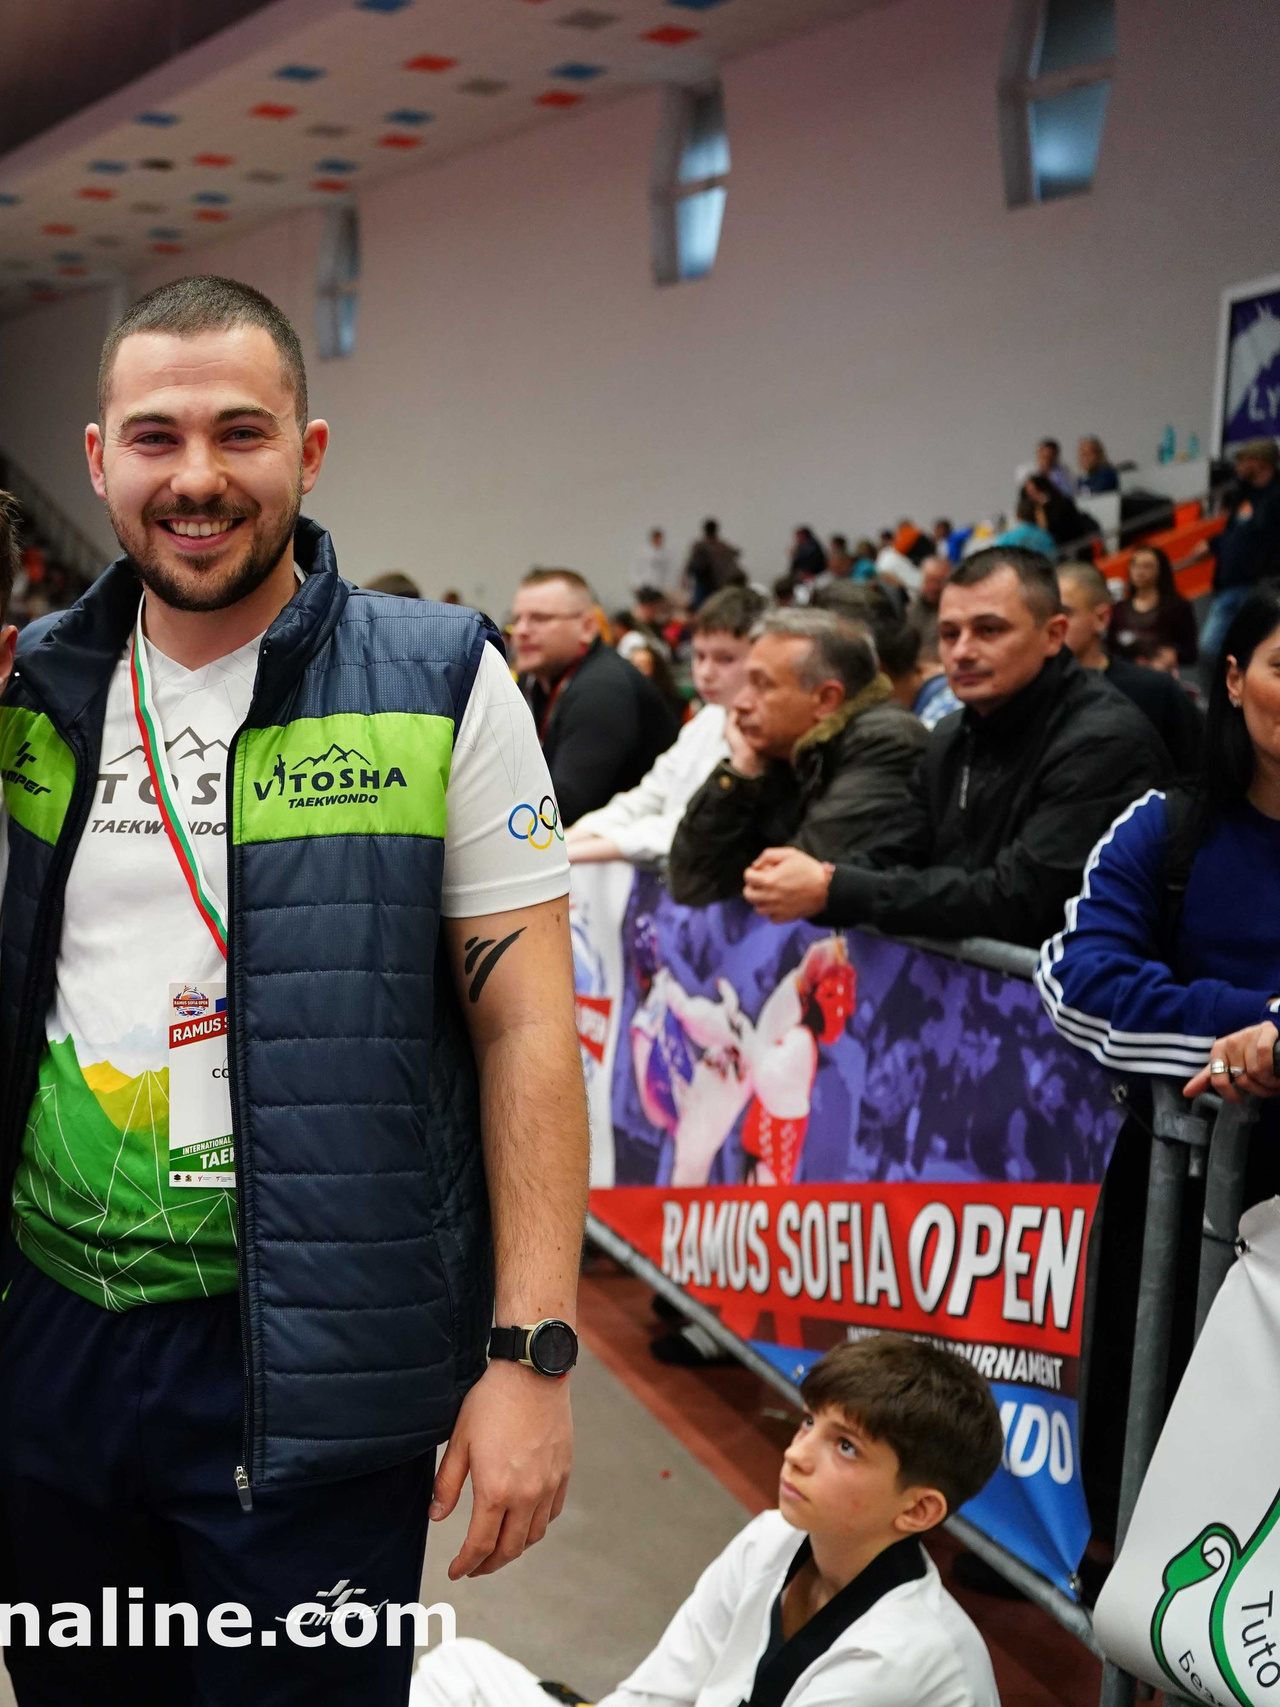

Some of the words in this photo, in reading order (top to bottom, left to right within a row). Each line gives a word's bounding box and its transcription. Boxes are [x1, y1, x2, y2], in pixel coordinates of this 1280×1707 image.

[288, 793, 379, 809] TAEKWONDO
[91, 819, 228, 836] TAEKWNDO
[173, 1017, 222, 1043] RAMUS
[182, 1136, 232, 1156] INTERNATIONAL
[661, 1200, 770, 1295] RAMUS
[776, 1201, 902, 1309] SOFIA
[907, 1202, 1086, 1330] OPEN
